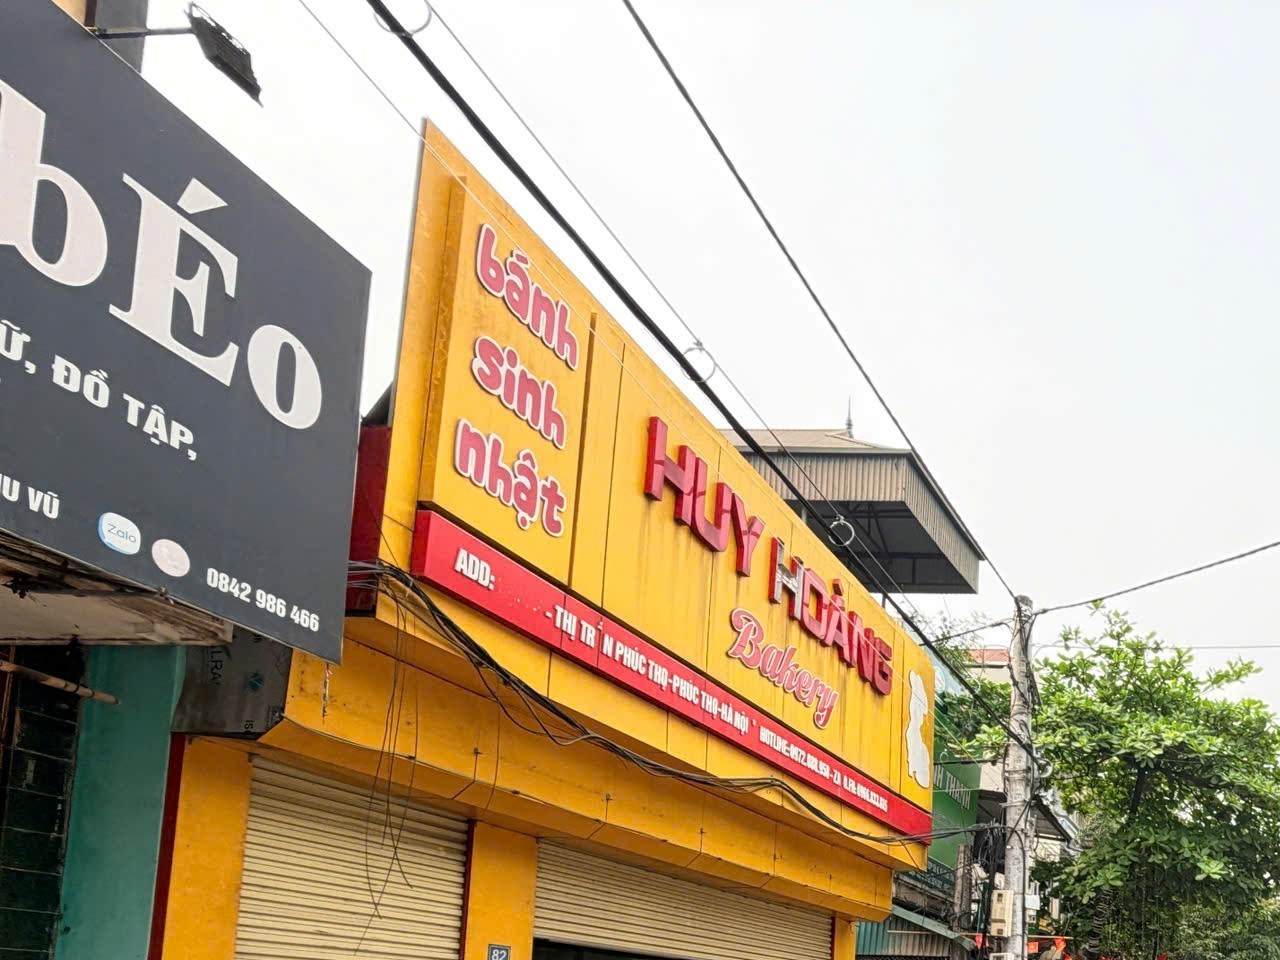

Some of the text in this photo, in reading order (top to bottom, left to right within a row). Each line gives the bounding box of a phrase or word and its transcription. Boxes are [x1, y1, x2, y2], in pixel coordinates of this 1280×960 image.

[476, 223, 580, 371] bánh
[52, 354, 110, 409] ĐỒ
[122, 393, 197, 461] TẬP,
[472, 335, 567, 449] sinh
[27, 486, 60, 520] VŨ
[107, 523, 137, 544] Zalo
[455, 418, 567, 537] nhật
[206, 567, 320, 632] 0842 986 466
[644, 416, 893, 697] HUY HOÀNG
[454, 548, 496, 591] ADD:
[554, 604, 577, 641] THỊ
[580, 618, 614, 658] TRN
[614, 637, 647, 675] PHÚC
[734, 711, 749, 735] NỘI
[728, 608, 840, 729] Bakery
